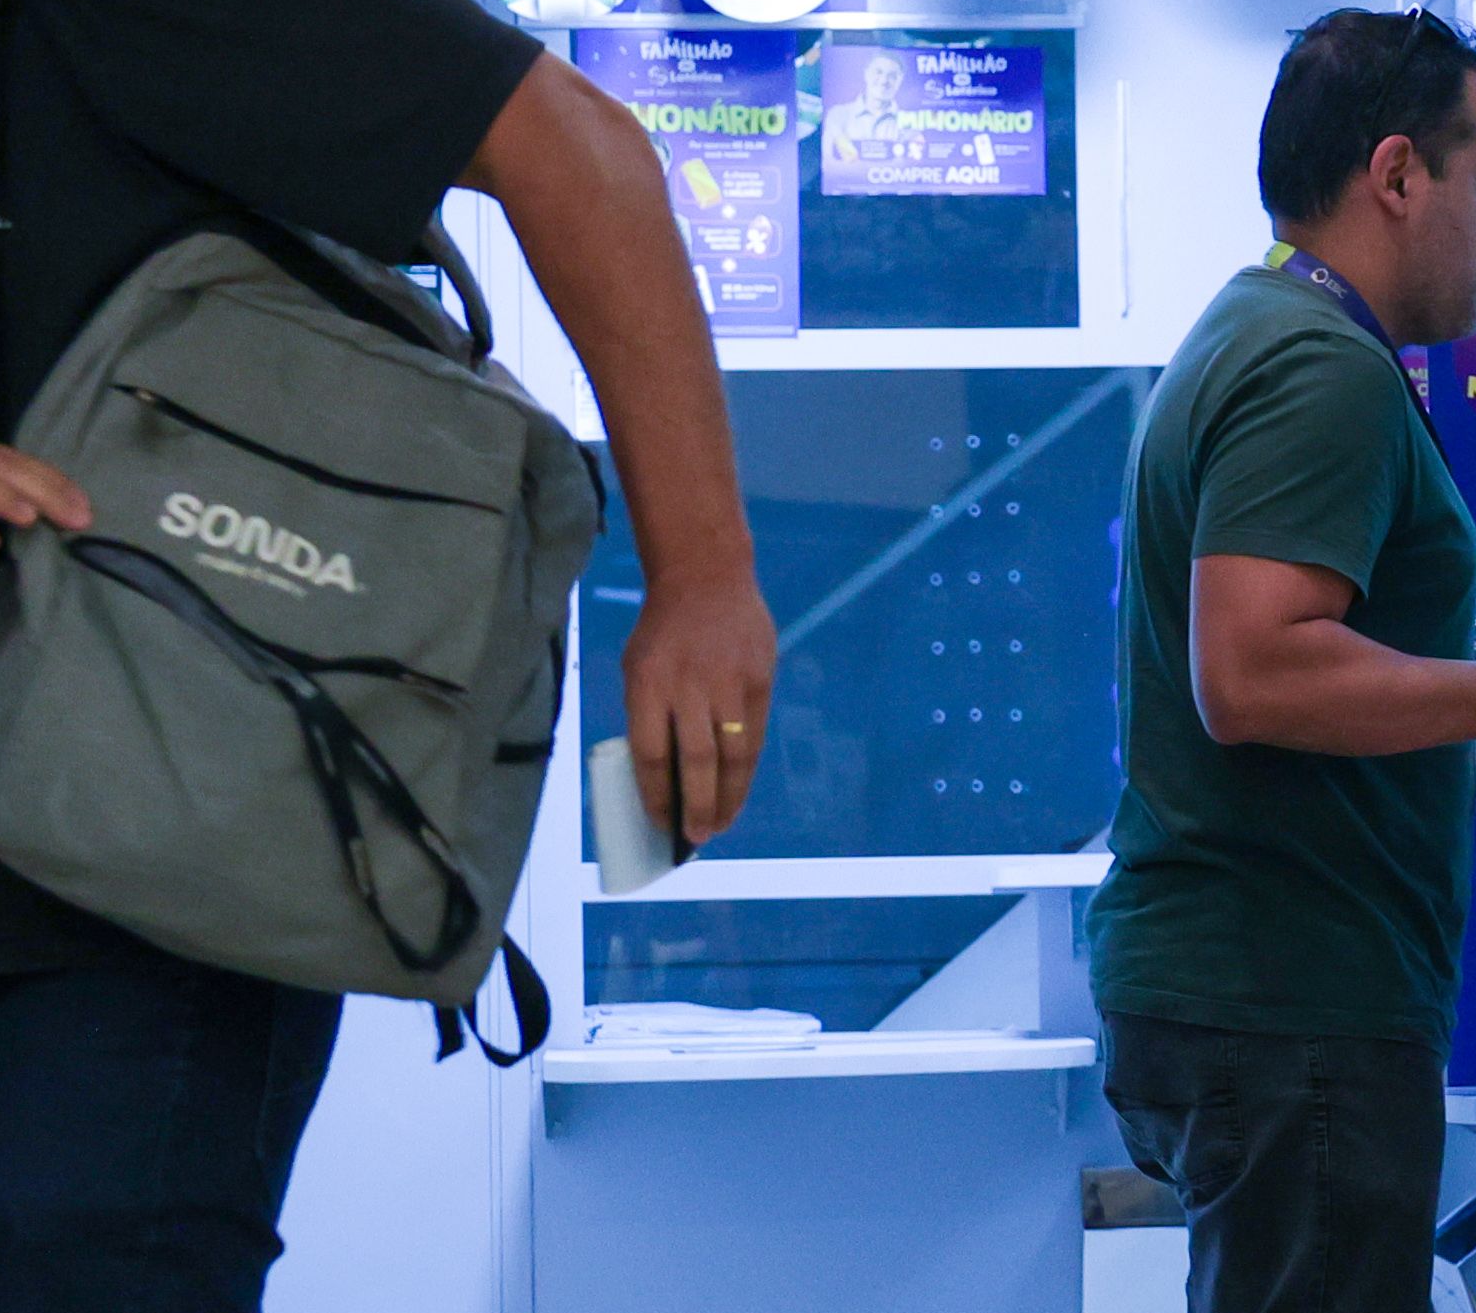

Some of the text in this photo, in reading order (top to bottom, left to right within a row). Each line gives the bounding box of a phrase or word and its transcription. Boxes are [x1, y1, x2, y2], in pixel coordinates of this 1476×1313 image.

[868, 166, 1000, 184] COMPRE AQUI!
[158, 492, 358, 592] SONDA
